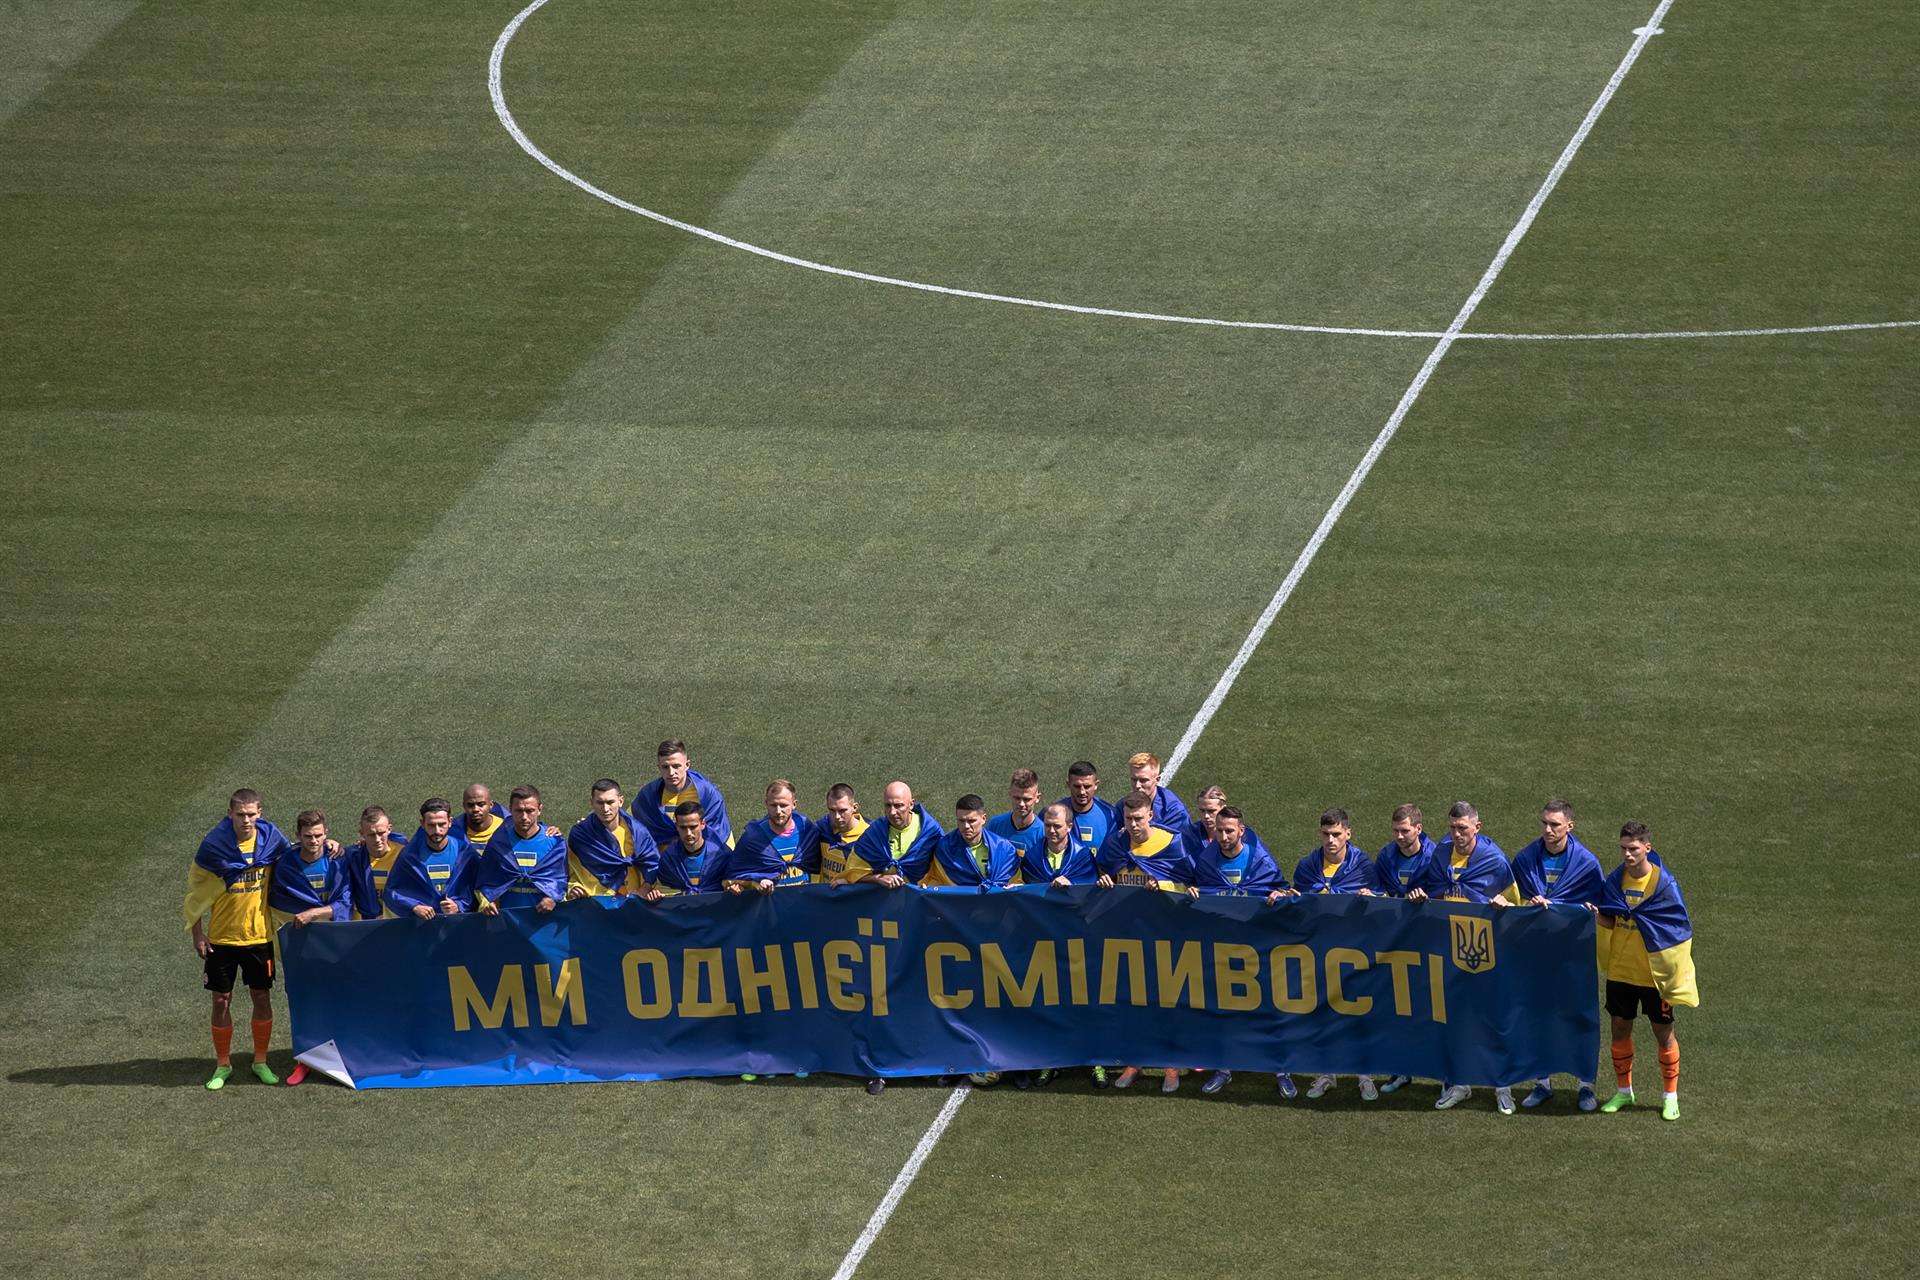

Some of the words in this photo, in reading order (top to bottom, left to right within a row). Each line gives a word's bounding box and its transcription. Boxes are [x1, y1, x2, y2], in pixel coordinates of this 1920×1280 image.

[447, 957, 588, 1031] МИ
[621, 917, 899, 1019] ОДНІЄЇ
[924, 937, 1447, 1024] СМІЛИВОСТІ
